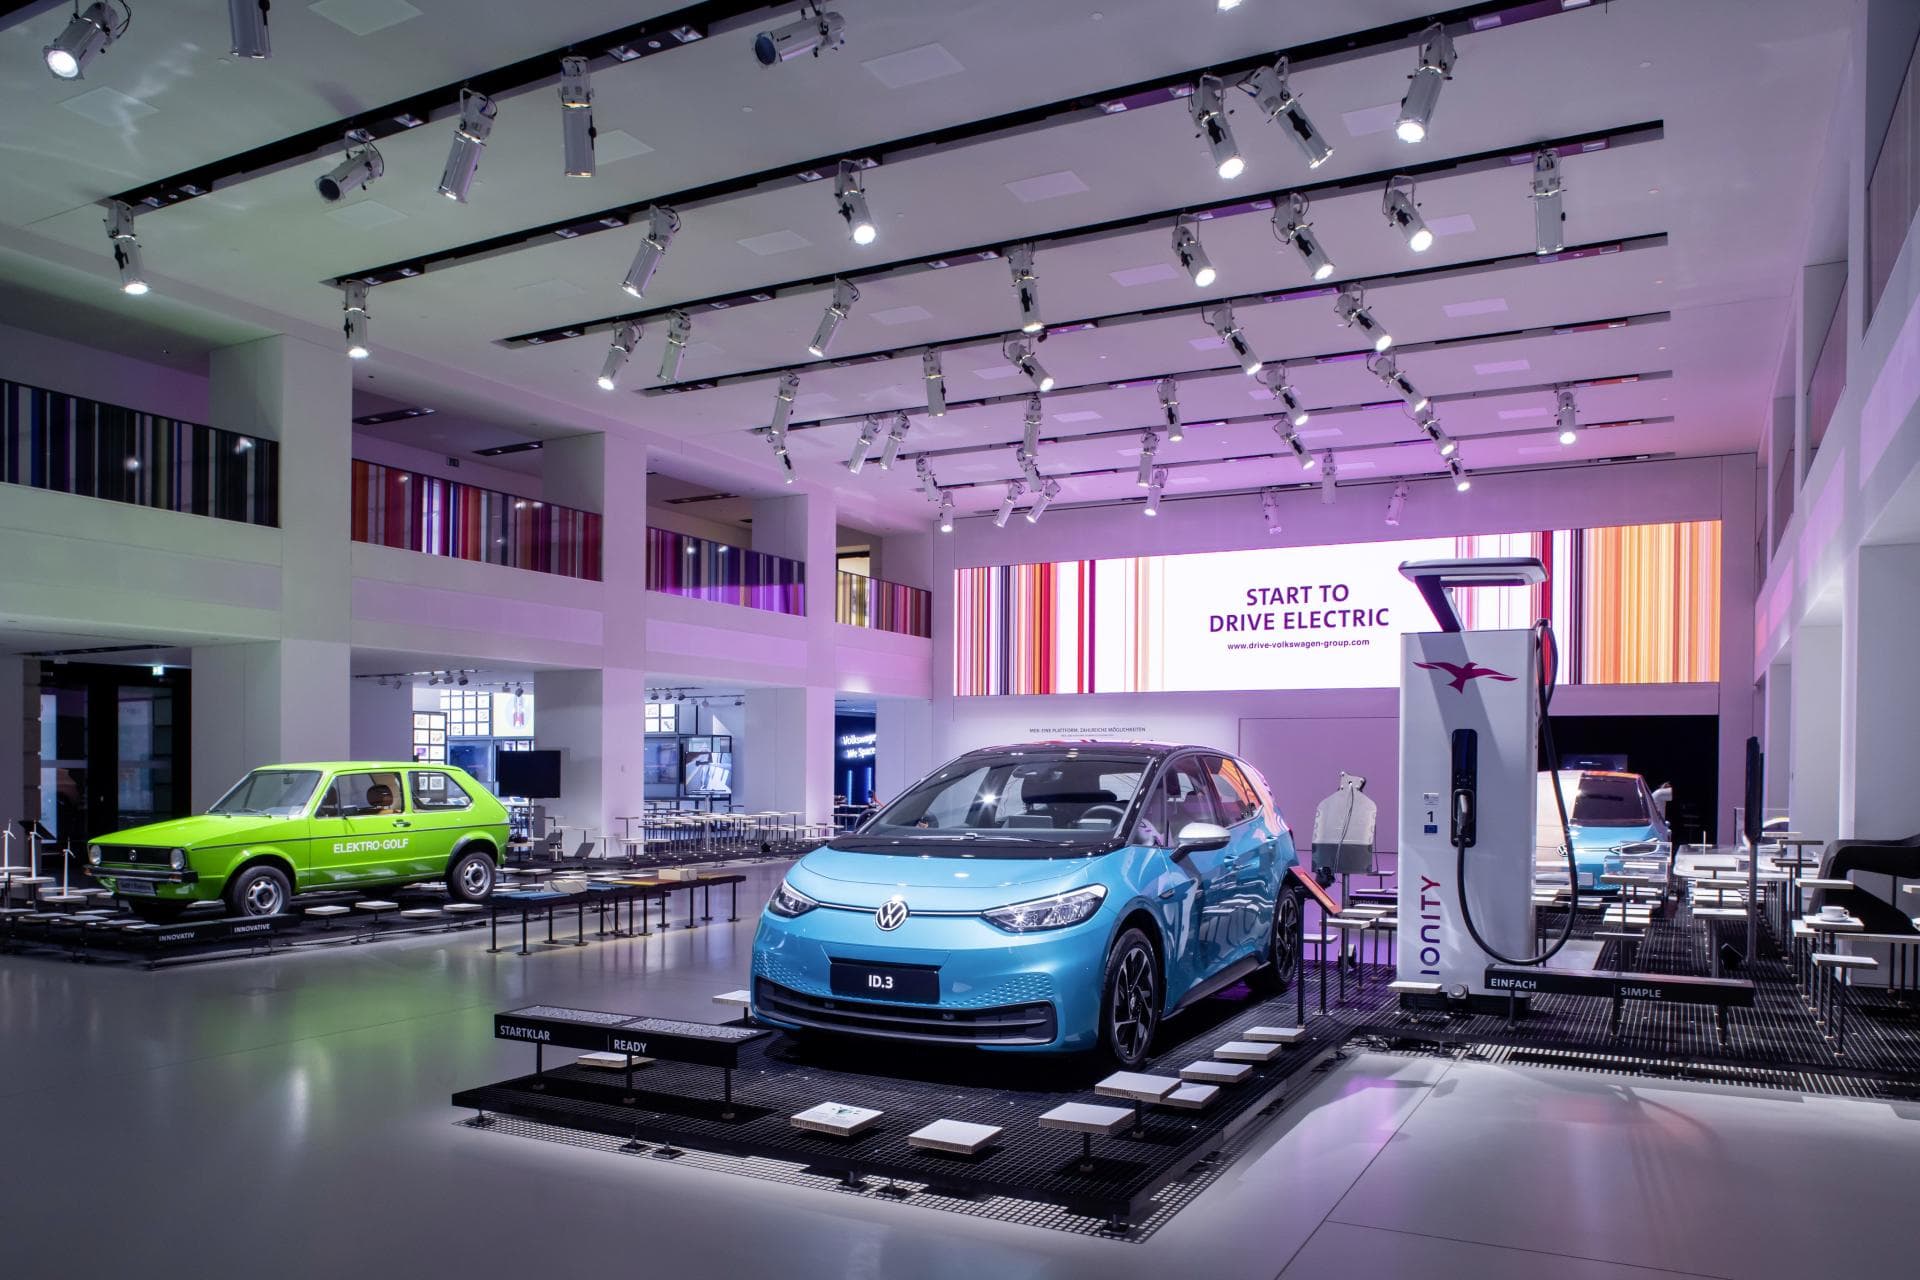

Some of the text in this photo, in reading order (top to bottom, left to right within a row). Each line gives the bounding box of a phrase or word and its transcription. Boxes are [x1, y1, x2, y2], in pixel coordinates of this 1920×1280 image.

[1246, 584, 1349, 606] START TO
[1210, 608, 1389, 632] DRIVE ELECTRIC
[1227, 638, 1370, 650] www.drive-volkswagen-group.com
[842, 733, 877, 746] Volkswage
[1426, 810, 1434, 823] 1
[234, 923, 271, 933] INNOVATIVE
[1420, 875, 1441, 976] IONITY
[159, 932, 195, 942] INNOVATIV
[868, 974, 894, 989] ID.3
[1490, 978, 1537, 990] EINFACH
[1620, 987, 1662, 998] SIMPLE
[500, 1025, 550, 1041] STARTKLAR
[613, 1039, 647, 1053] READY
